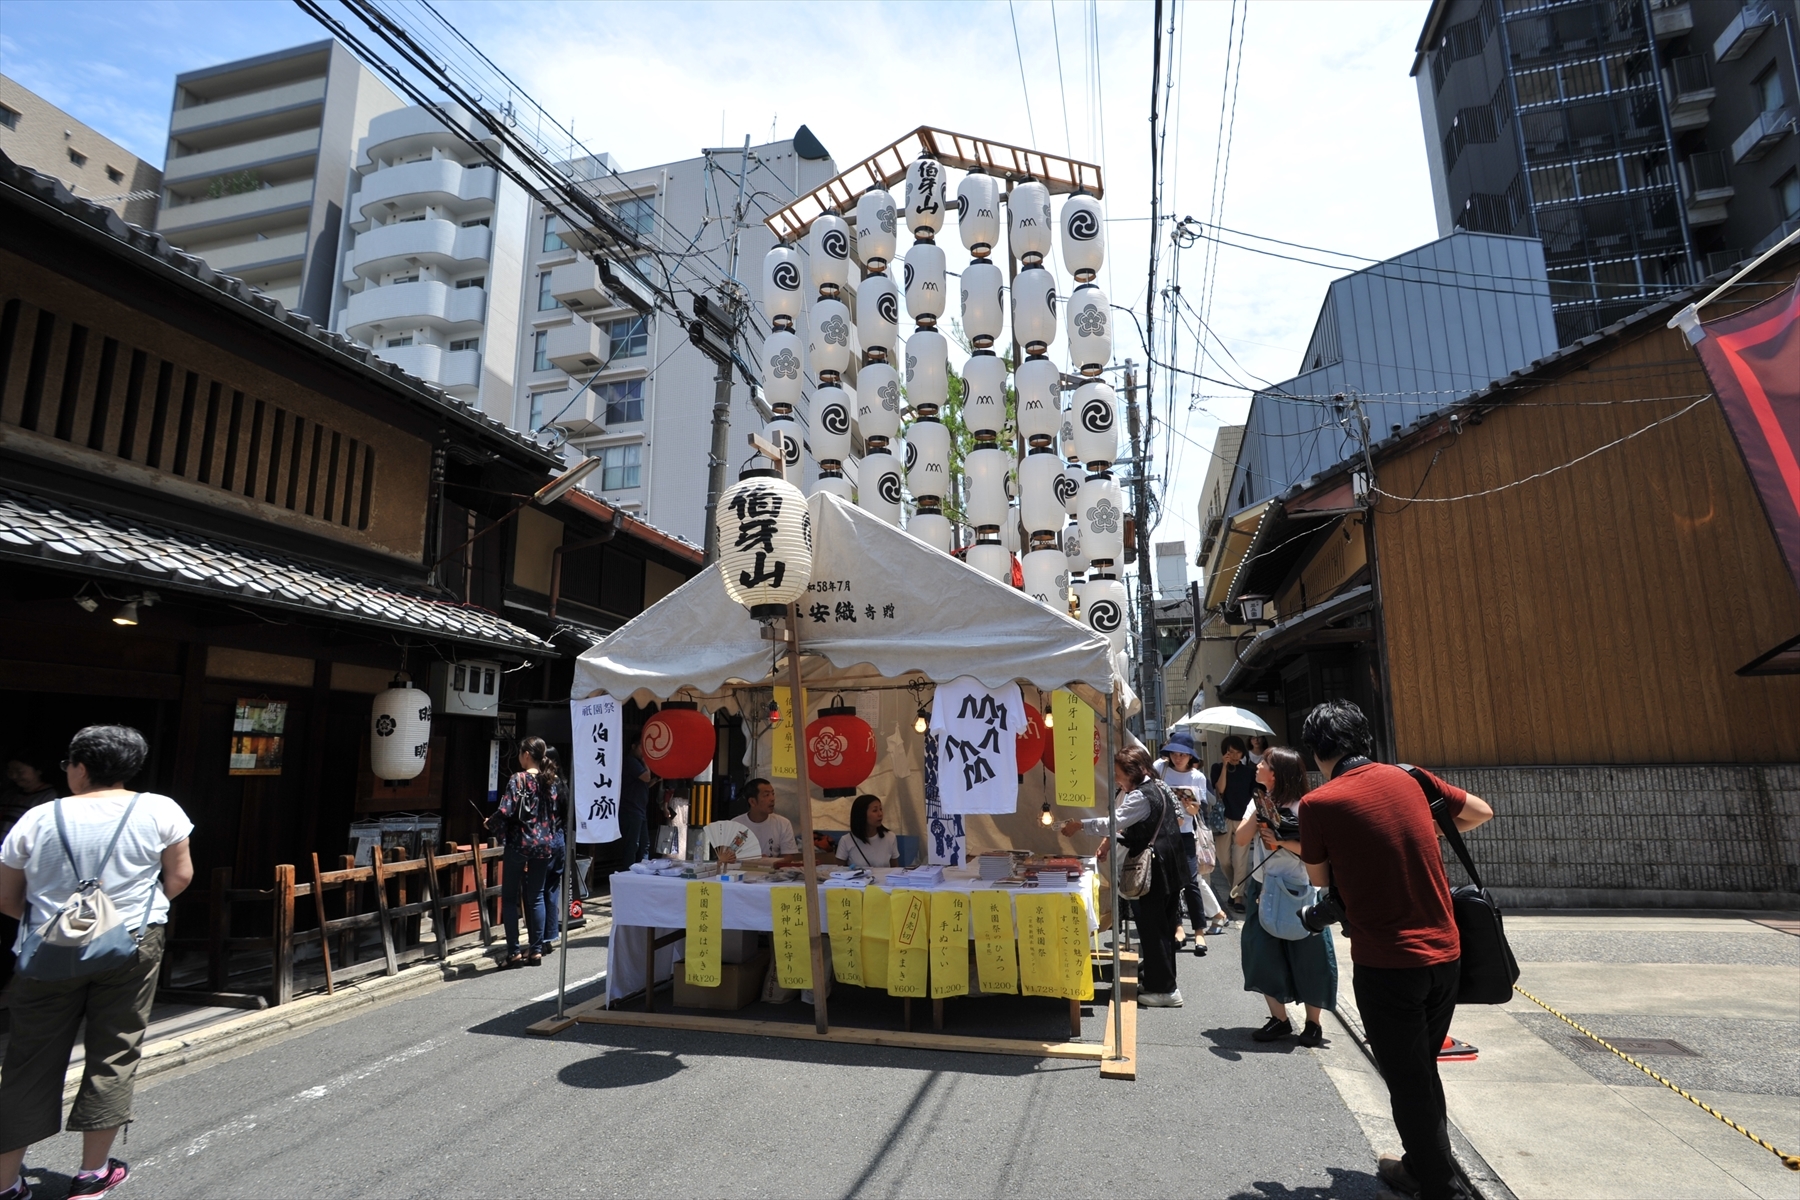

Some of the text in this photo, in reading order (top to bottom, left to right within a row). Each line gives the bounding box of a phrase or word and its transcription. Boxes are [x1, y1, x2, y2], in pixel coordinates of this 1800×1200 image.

[728, 484, 786, 589] 伯牙山
[592, 723, 613, 788] 伯牙山
[1068, 694, 1078, 788] 伯牙山Tシャツ
[781, 903, 793, 973] 御神木お守り
[793, 893, 804, 926] 伯牙山
[841, 897, 855, 968] 伯牙山タオル
[953, 899, 963, 932] 伯牙山
[990, 903, 1005, 971] 祇園祭のひみつ
[1036, 906, 1046, 957] 京都祇園祭
[1060, 915, 1069, 944] すべて
[939, 921, 948, 967] 手ぬぐい
